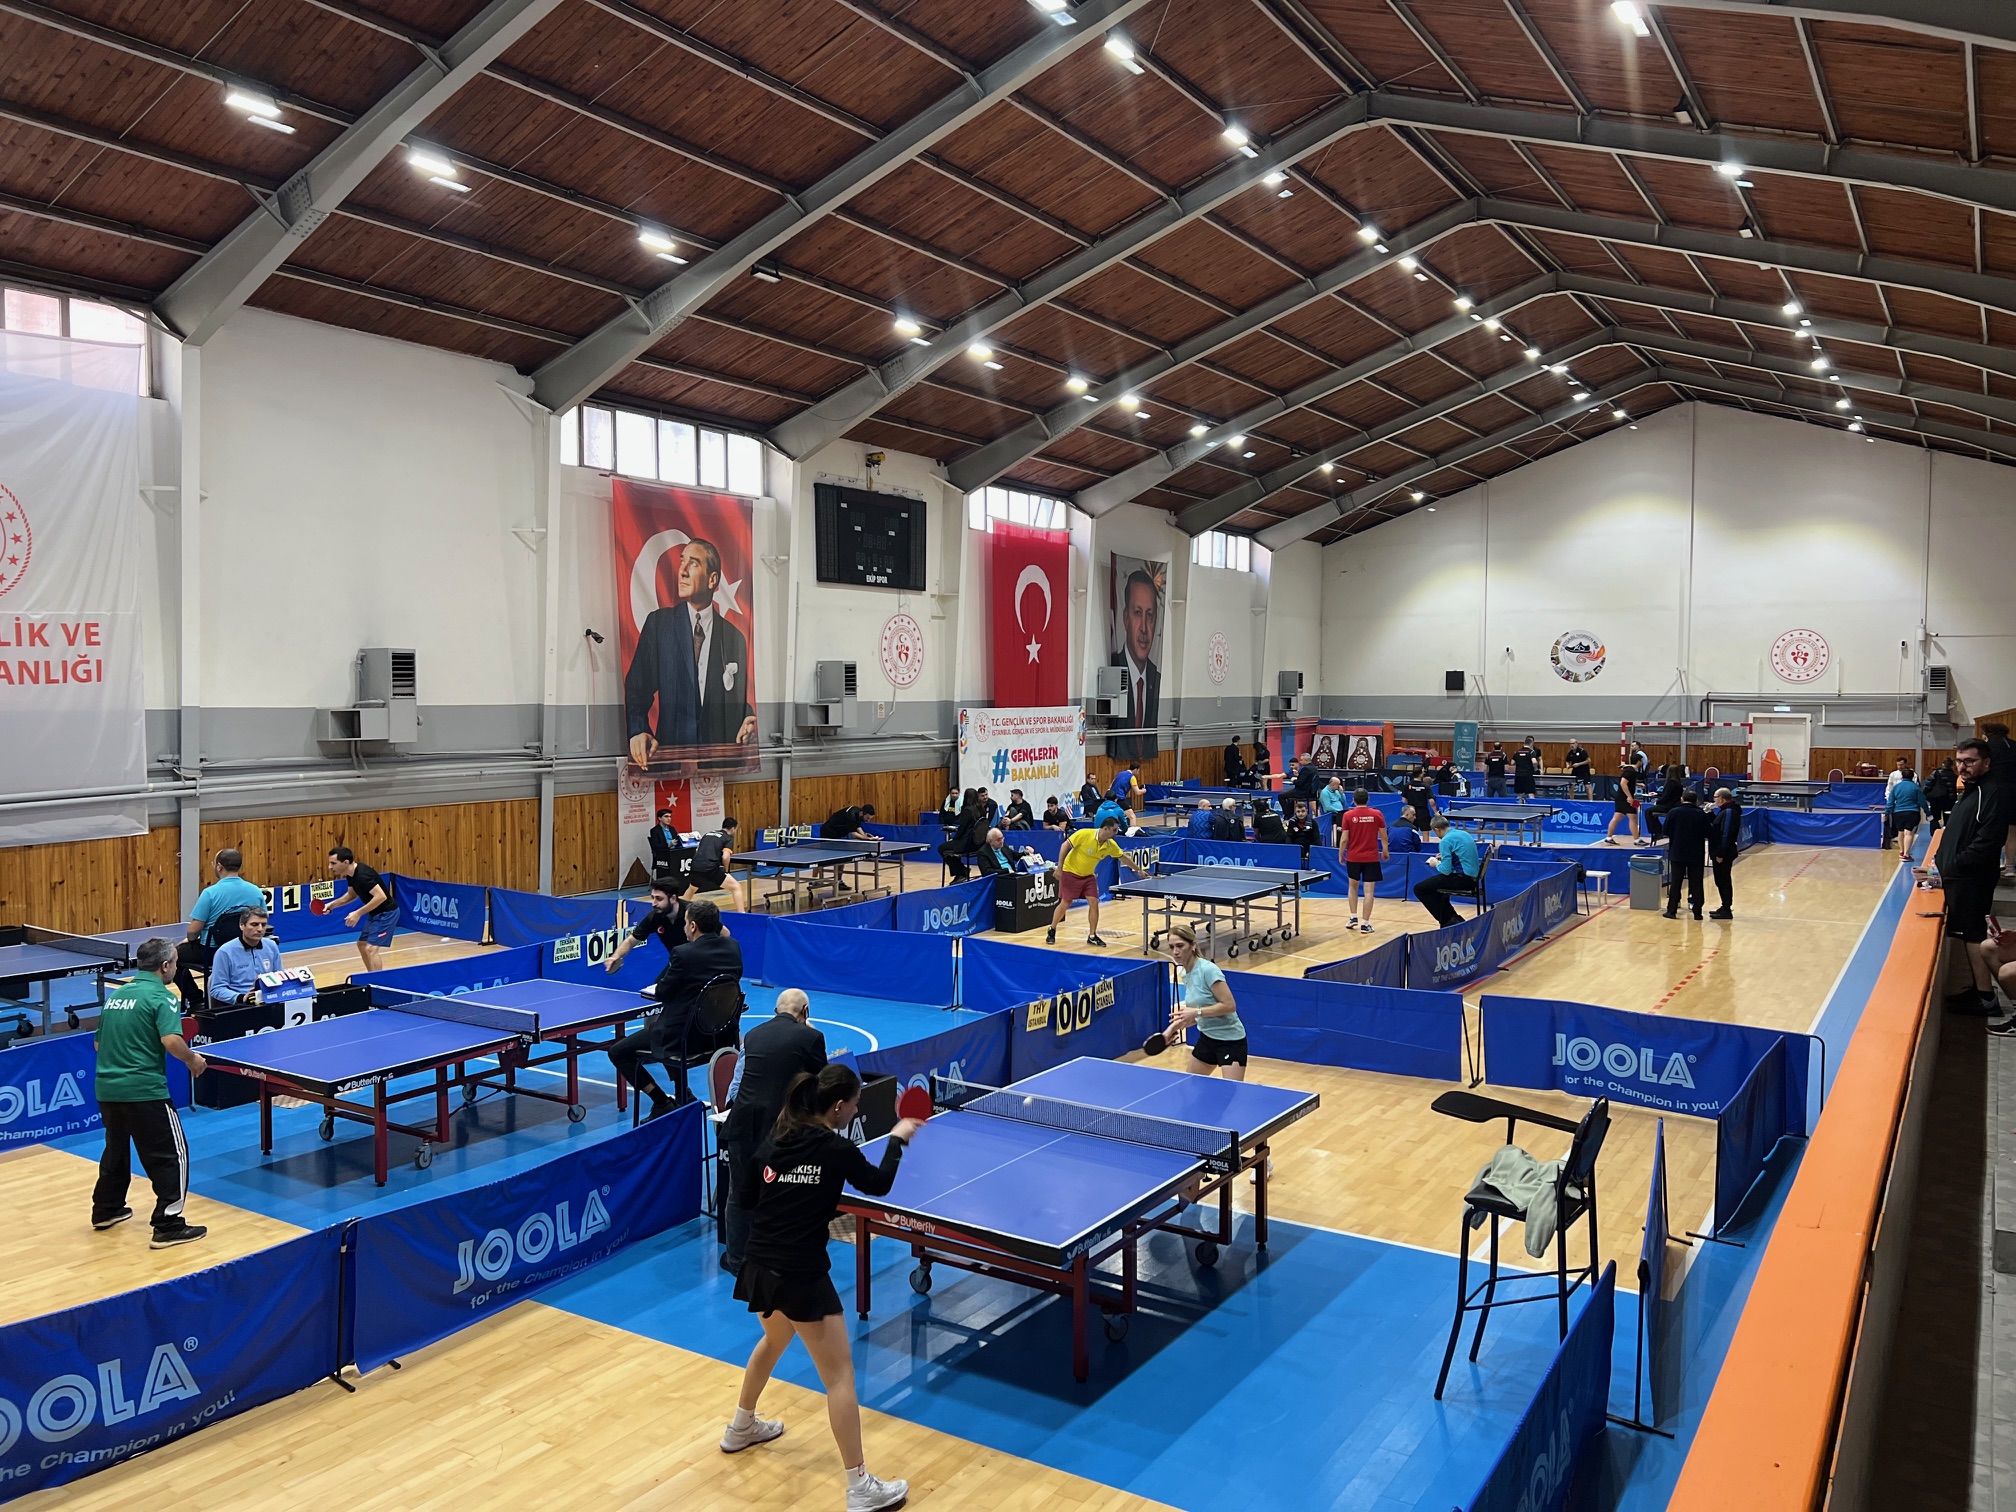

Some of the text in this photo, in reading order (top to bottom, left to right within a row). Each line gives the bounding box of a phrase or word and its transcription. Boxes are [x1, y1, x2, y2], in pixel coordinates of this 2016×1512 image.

[60, 622, 101, 646] VE
[1002, 715, 1025, 729] GENÇLİK
[1025, 717, 1033, 725] VE
[1033, 716, 1047, 726] SPOR
[1047, 714, 1074, 725] BAKANLIĞI
[1012, 727, 1030, 736] GENÇLİK
[1011, 745, 1059, 765] GENÇLERİN
[1011, 762, 1060, 781] BAKANLIĞI
[1551, 811, 1602, 826] JOOLA
[1037, 876, 1043, 889] 5
[284, 887, 299, 909] 1
[413, 892, 459, 919] JOOLA
[560, 938, 575, 946] TEKSAN
[588, 935, 603, 962] 0
[608, 932, 619, 958] 1
[1434, 937, 1475, 973] JOOLA
[299, 969, 311, 979] 3
[1032, 1002, 1047, 1015] THY
[1059, 992, 1090, 1030] 0 0
[351, 1074, 382, 1089] Butterfly
[1583, 1076, 1604, 1088] the
[1607, 1081, 1672, 1108] Champion
[1676, 1099, 1688, 1110] in
[1691, 1101, 1719, 1112] you!
[67, 1120, 80, 1131] in
[1209, 1159, 1229, 1168] JOOLA
[778, 1174, 820, 1184] AIRLINES
[899, 1214, 936, 1234] Butterfly
[1077, 1231, 1102, 1254] Butterfly
[470, 1289, 492, 1309] for
[496, 1279, 520, 1295] the
[524, 1257, 588, 1284] Champion
[591, 1250, 602, 1263] in
[40, 1433, 160, 1471] Champion
[167, 1421, 186, 1438] in
[192, 1389, 236, 1427] you!
